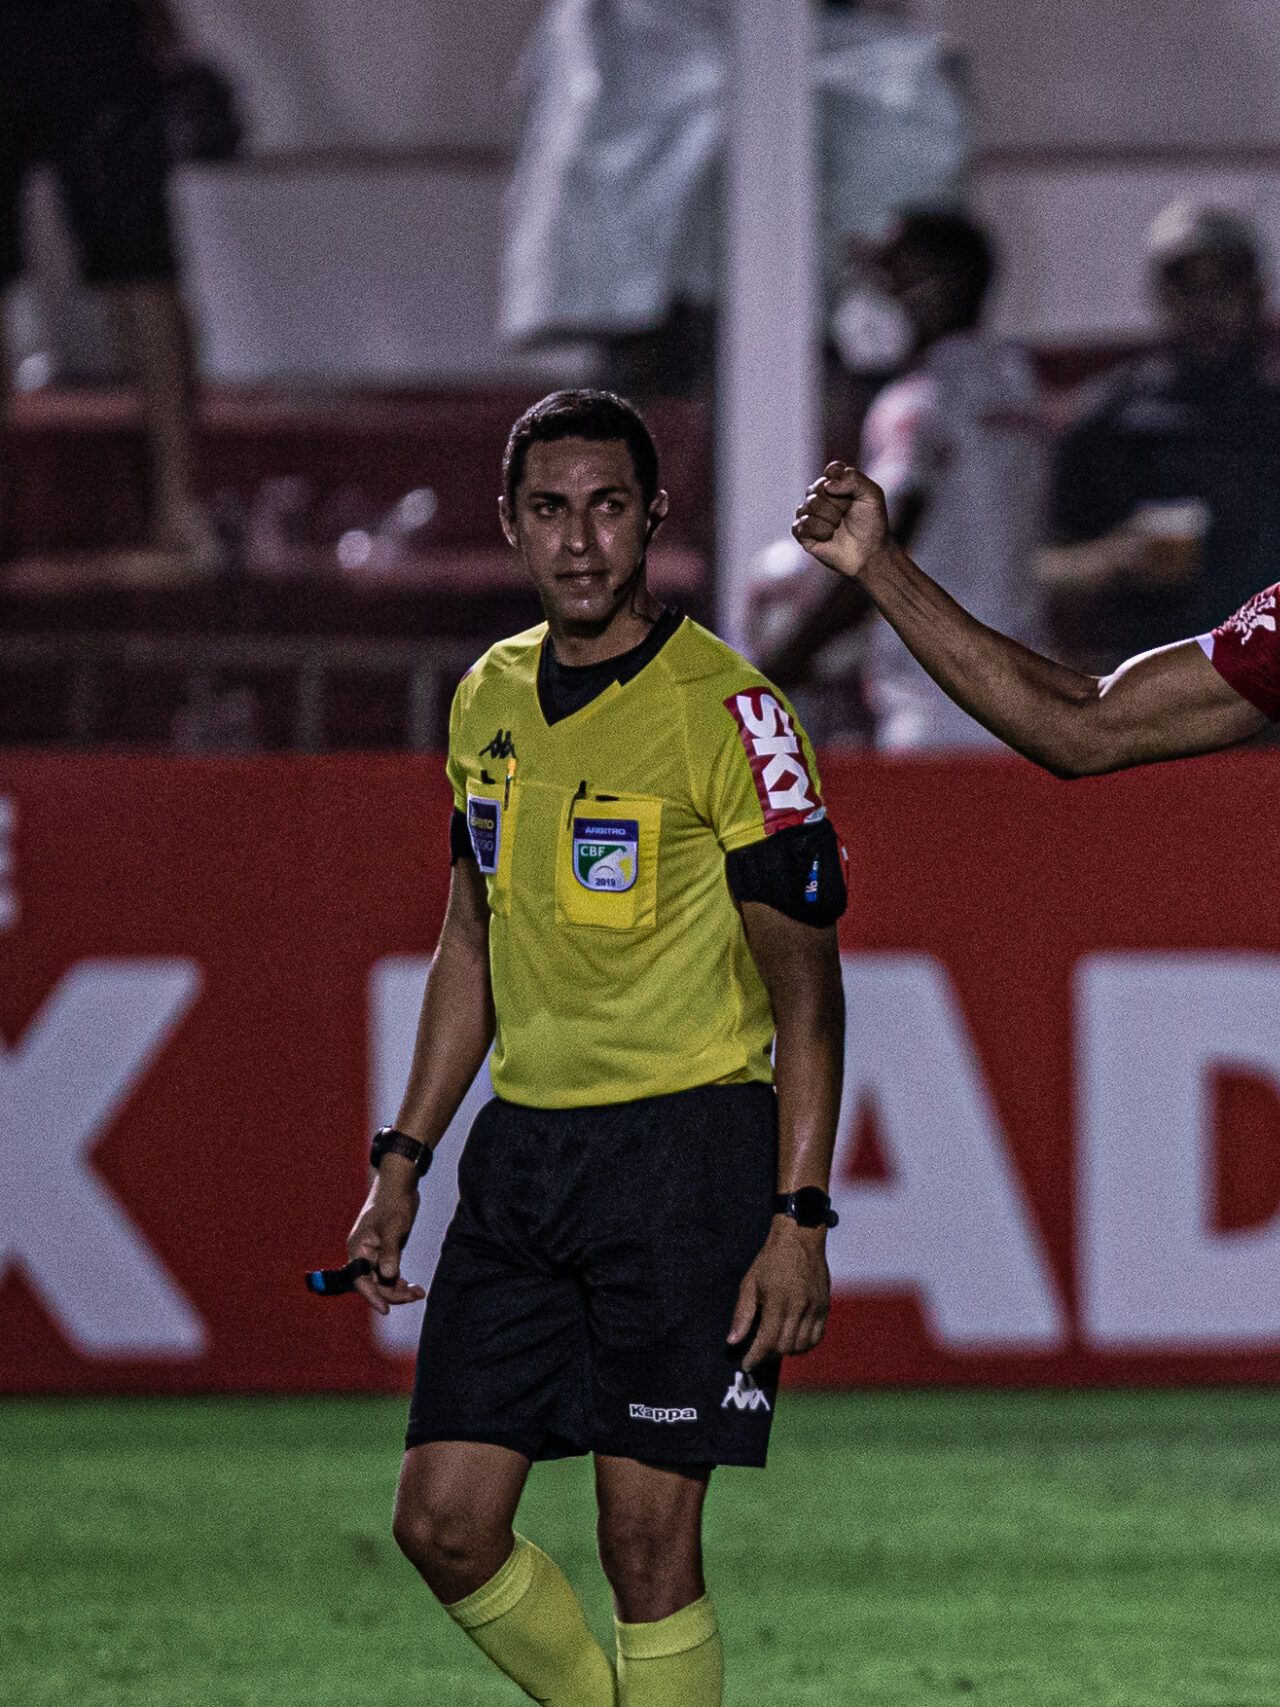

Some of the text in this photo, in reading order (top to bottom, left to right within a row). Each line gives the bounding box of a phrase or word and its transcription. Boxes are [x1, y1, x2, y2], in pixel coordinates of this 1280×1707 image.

[735, 692, 816, 811] SKY
[580, 845, 606, 857] CBF
[629, 1403, 698, 1423] Kappa
